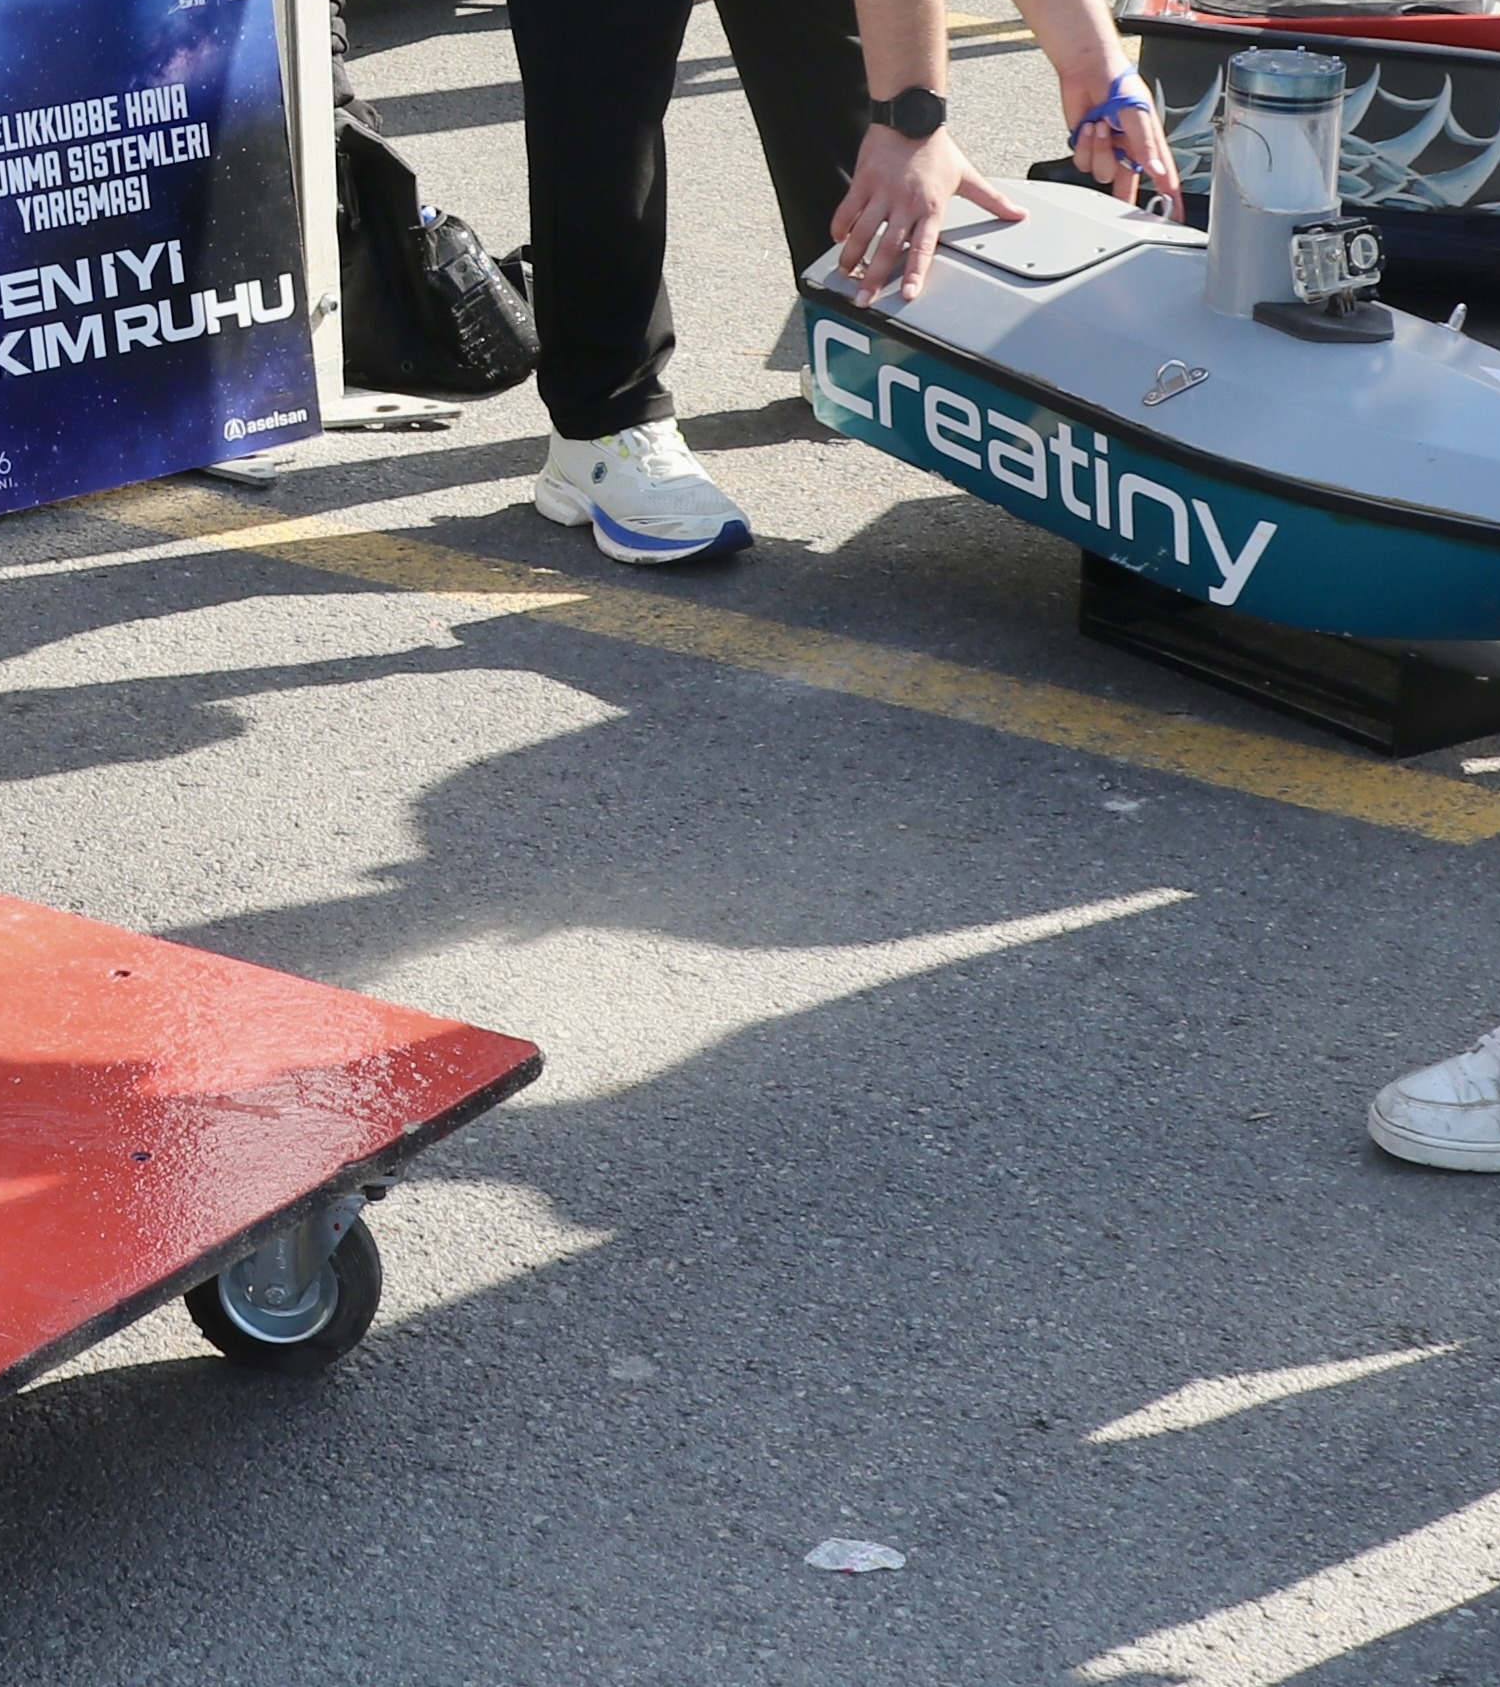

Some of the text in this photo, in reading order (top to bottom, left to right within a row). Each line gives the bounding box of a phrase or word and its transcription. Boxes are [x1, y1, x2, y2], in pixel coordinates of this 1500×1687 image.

[125, 83, 188, 124] HAVA
[67, 121, 212, 185] SİSTEMLERİ
[15, 181, 151, 234] YARIŞMASI
[116, 272, 295, 354] RUHU
[246, 407, 308, 433] aselsan
[812, 318, 1279, 608] Creatiny
